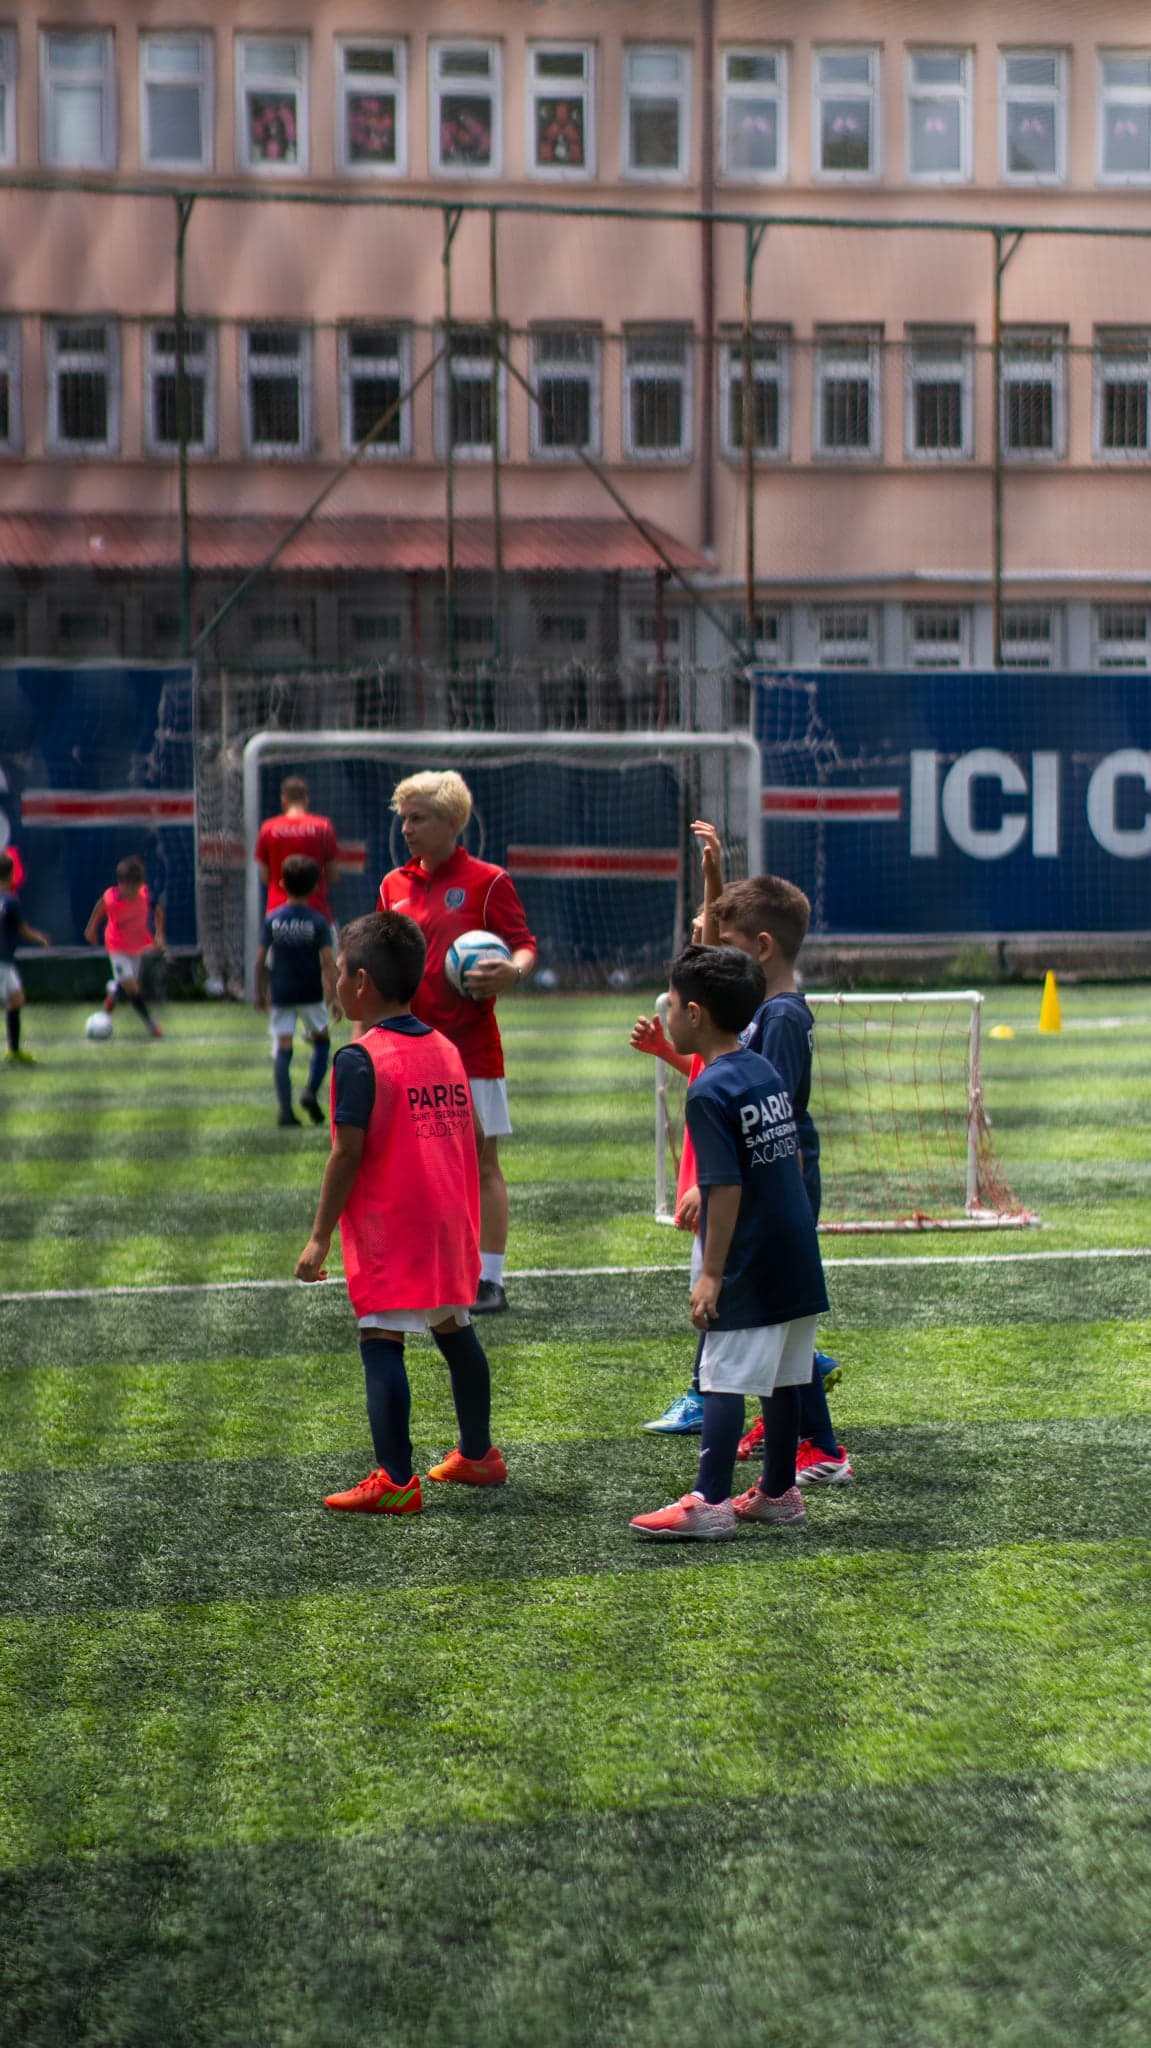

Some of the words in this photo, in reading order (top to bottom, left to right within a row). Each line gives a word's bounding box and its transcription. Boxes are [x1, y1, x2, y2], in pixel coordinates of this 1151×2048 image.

[909, 748, 1059, 860] ICI
[408, 1084, 468, 1111] PARIS
[740, 1091, 793, 1135] PARIS
